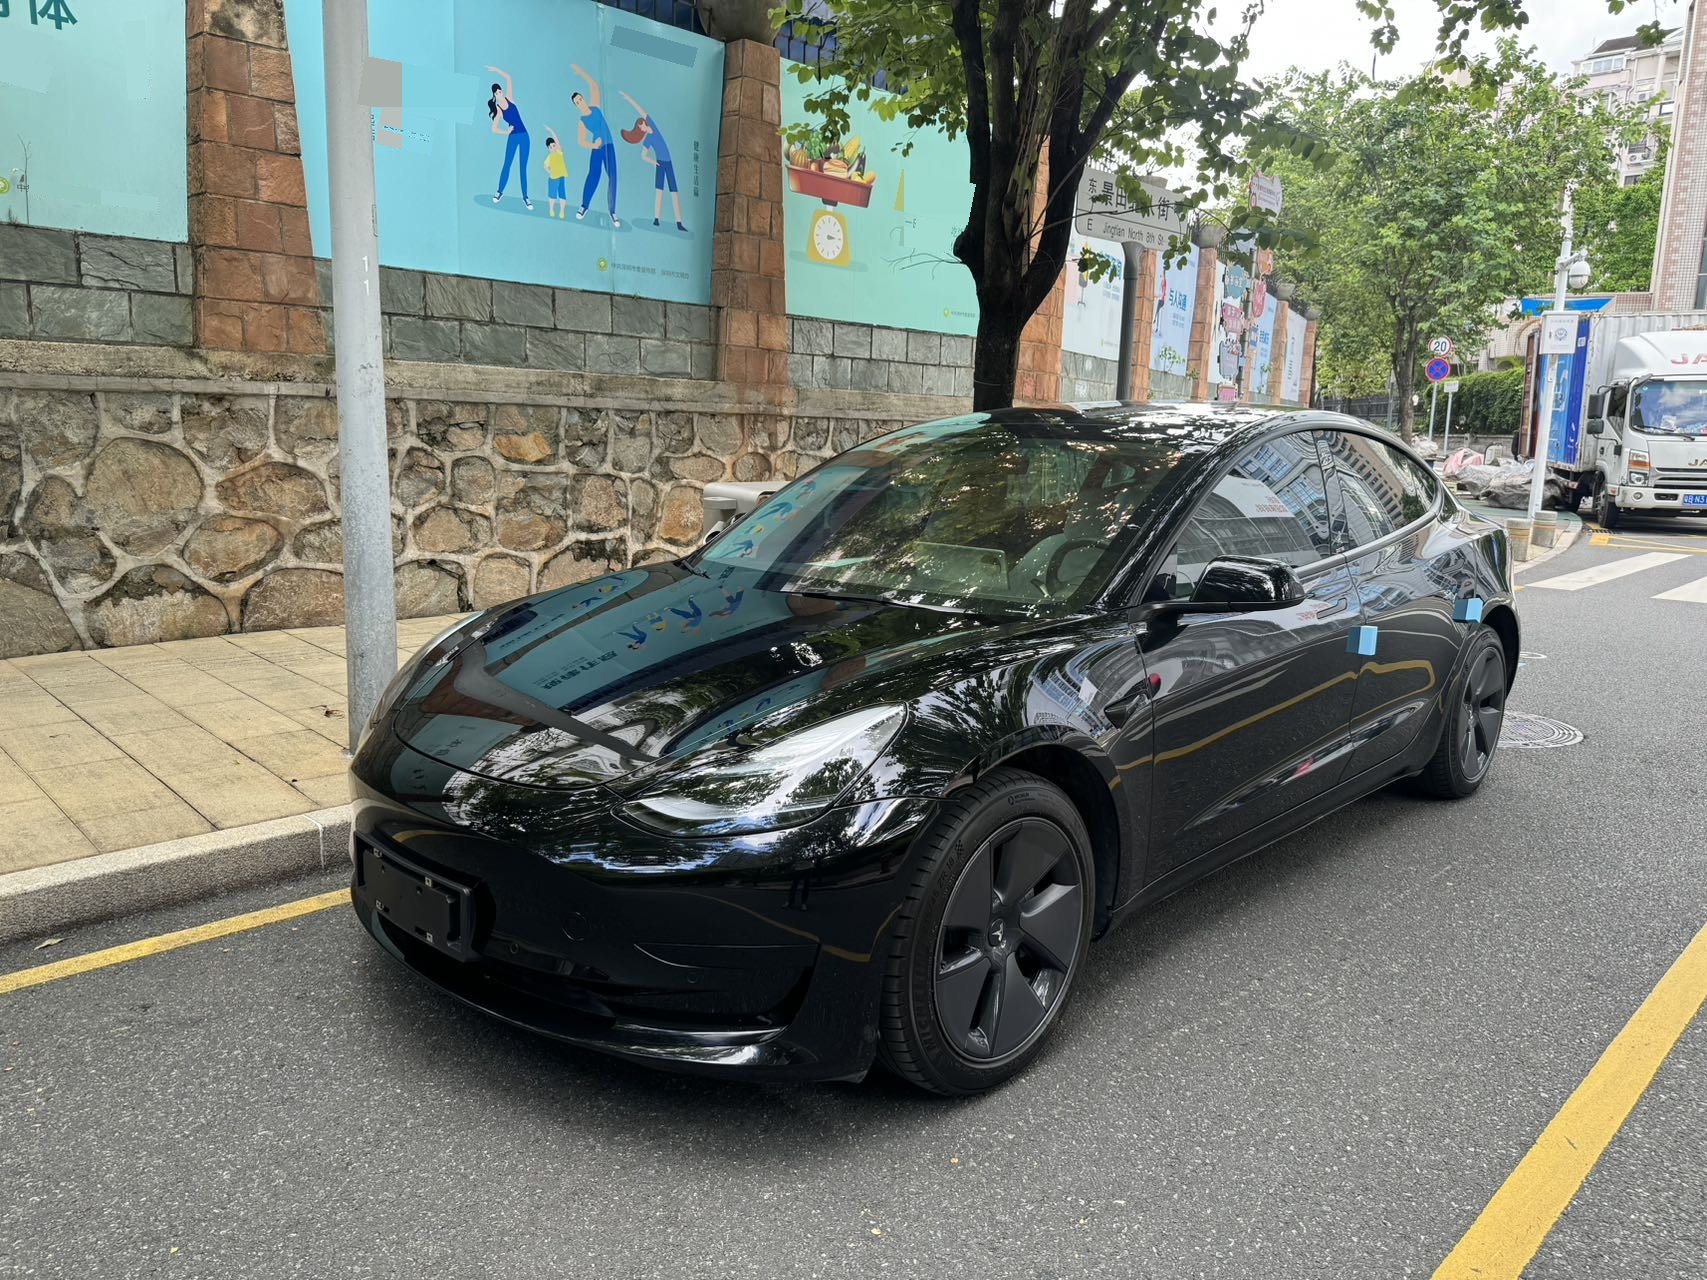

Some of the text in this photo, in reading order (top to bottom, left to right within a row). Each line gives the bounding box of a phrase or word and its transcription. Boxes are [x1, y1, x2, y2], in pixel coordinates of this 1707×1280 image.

[1087, 218, 1093, 231] E
[1102, 221, 1125, 239] Jingtian
[1127, 226, 1144, 241] North
[1145, 231, 1156, 243] 8th
[1433, 340, 1447, 352] 20
